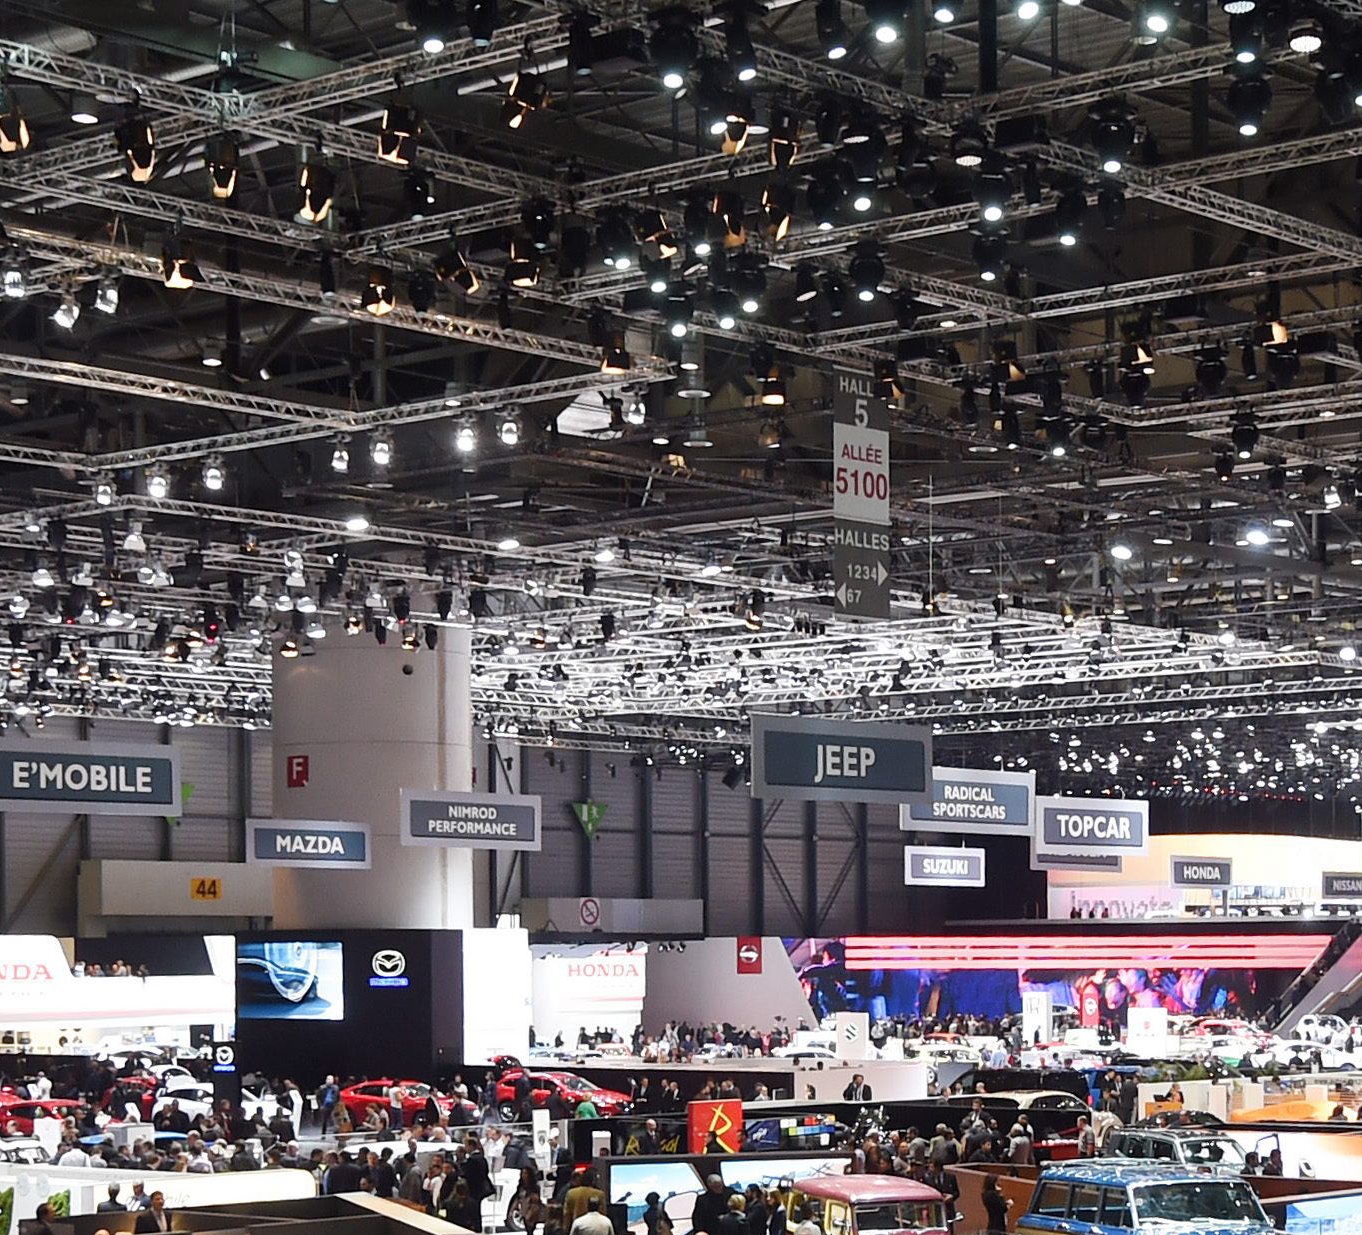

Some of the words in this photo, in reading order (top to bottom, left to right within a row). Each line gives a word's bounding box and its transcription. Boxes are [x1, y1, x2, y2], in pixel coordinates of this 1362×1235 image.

[839, 375, 875, 398] HALL
[854, 398, 869, 429] 5
[841, 442, 883, 465] ALLÉE
[836, 466, 888, 500] 5100
[834, 527, 890, 551] HALLES
[292, 759, 303, 779] F
[814, 744, 876, 784] JEEP
[944, 785, 994, 802] RADICAL
[448, 805, 497, 820] NIMROD
[933, 802, 1006, 820] SPORTSCARS
[428, 820, 517, 836] PERFORMANCE
[1056, 814, 1132, 840] TOPCAR
[275, 835, 345, 855] MAZDA
[923, 858, 969, 876] SUZUKI
[1183, 865, 1221, 880] HONDA
[195, 880, 217, 898] 44
[1333, 879, 1362, 892] NISSAN
[568, 964, 639, 977] HONDA
